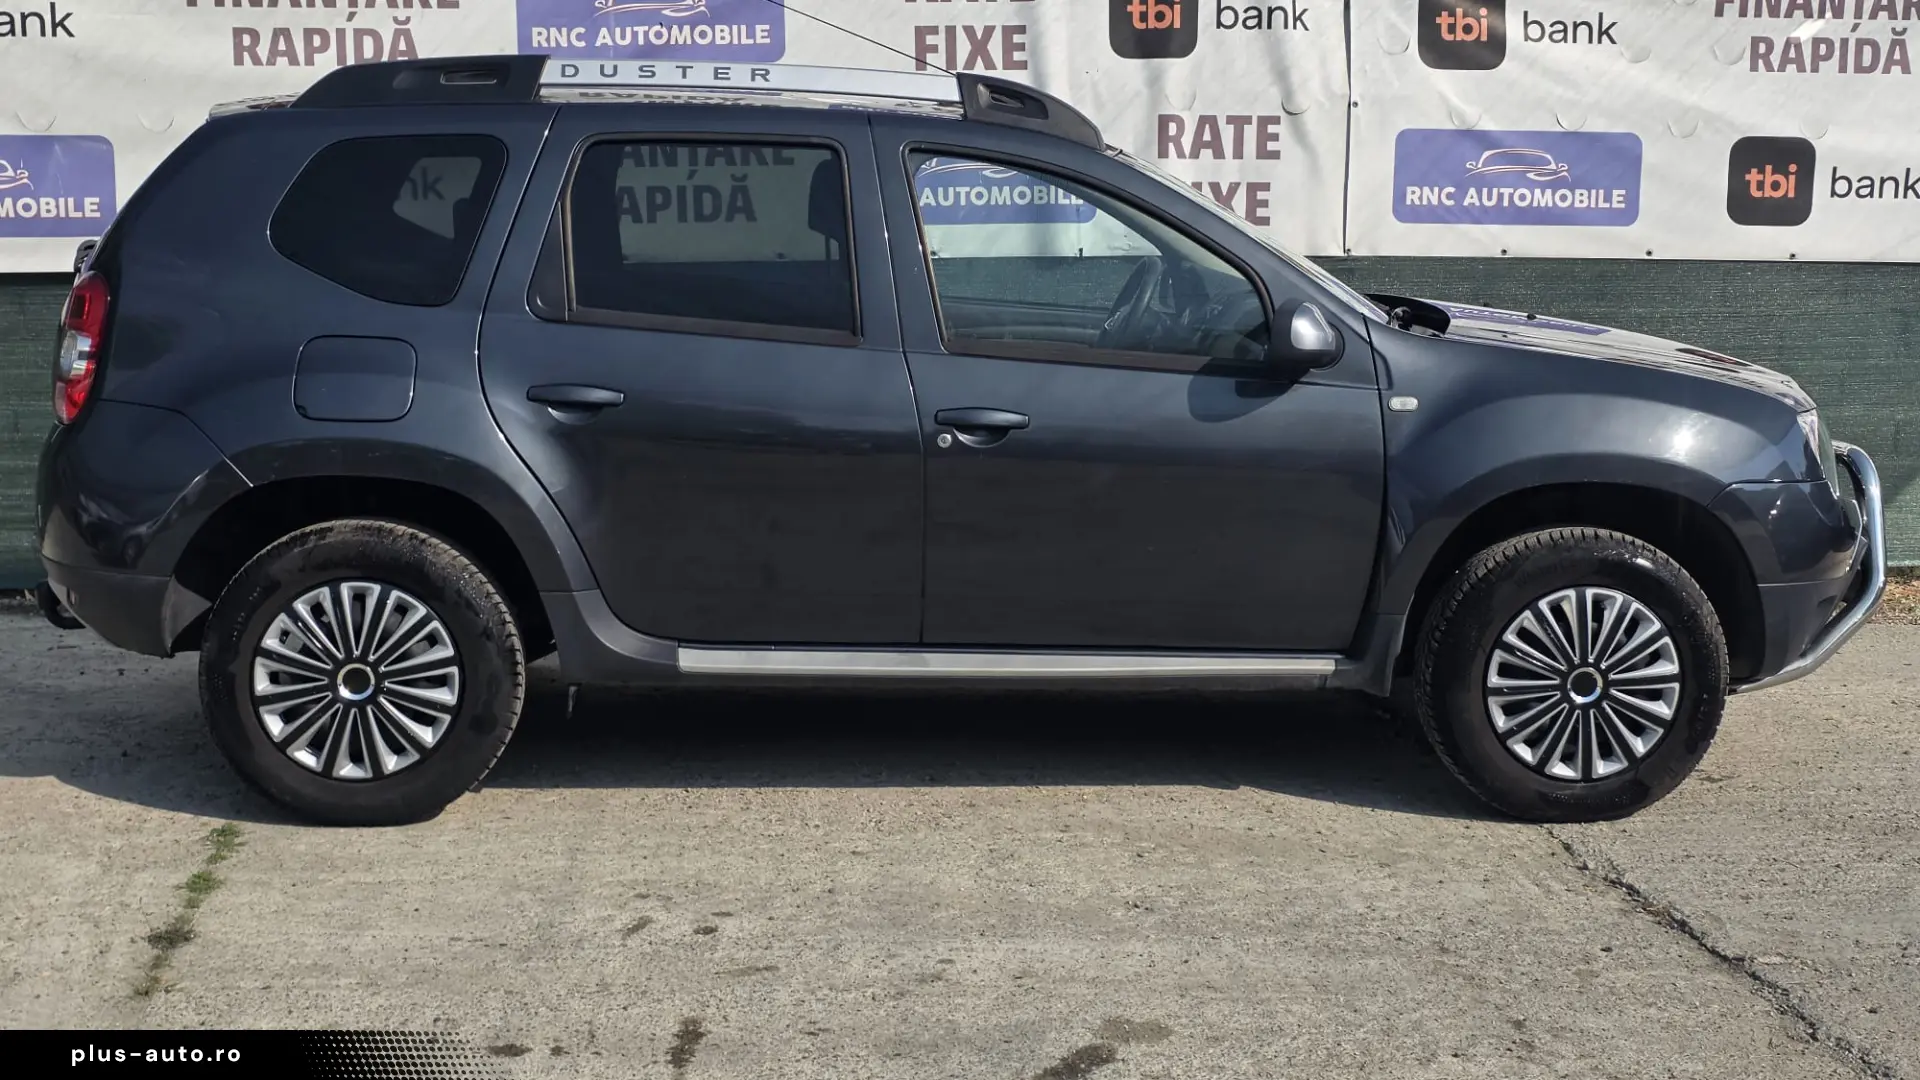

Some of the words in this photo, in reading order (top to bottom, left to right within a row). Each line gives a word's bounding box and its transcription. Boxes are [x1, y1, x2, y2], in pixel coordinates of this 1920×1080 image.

[0, 1, 75, 38] ank
[1126, 0, 1182, 30] tbi
[1215, 0, 1311, 32] bank
[1435, 7, 1489, 42] tbi
[1522, 10, 1619, 45] bank
[531, 26, 587, 48] RNC
[594, 23, 772, 47] AUTOMOBILE
[913, 24, 1029, 72] FIXE
[559, 63, 772, 83] DUSTER
[1157, 113, 1282, 161] RATE
[1405, 186, 1457, 206] RNC
[1462, 187, 1627, 209] AUTOMOBILE
[1745, 163, 1798, 198] tbi
[1830, 166, 1920, 200] bank
[0, 196, 101, 218] MOBILE
